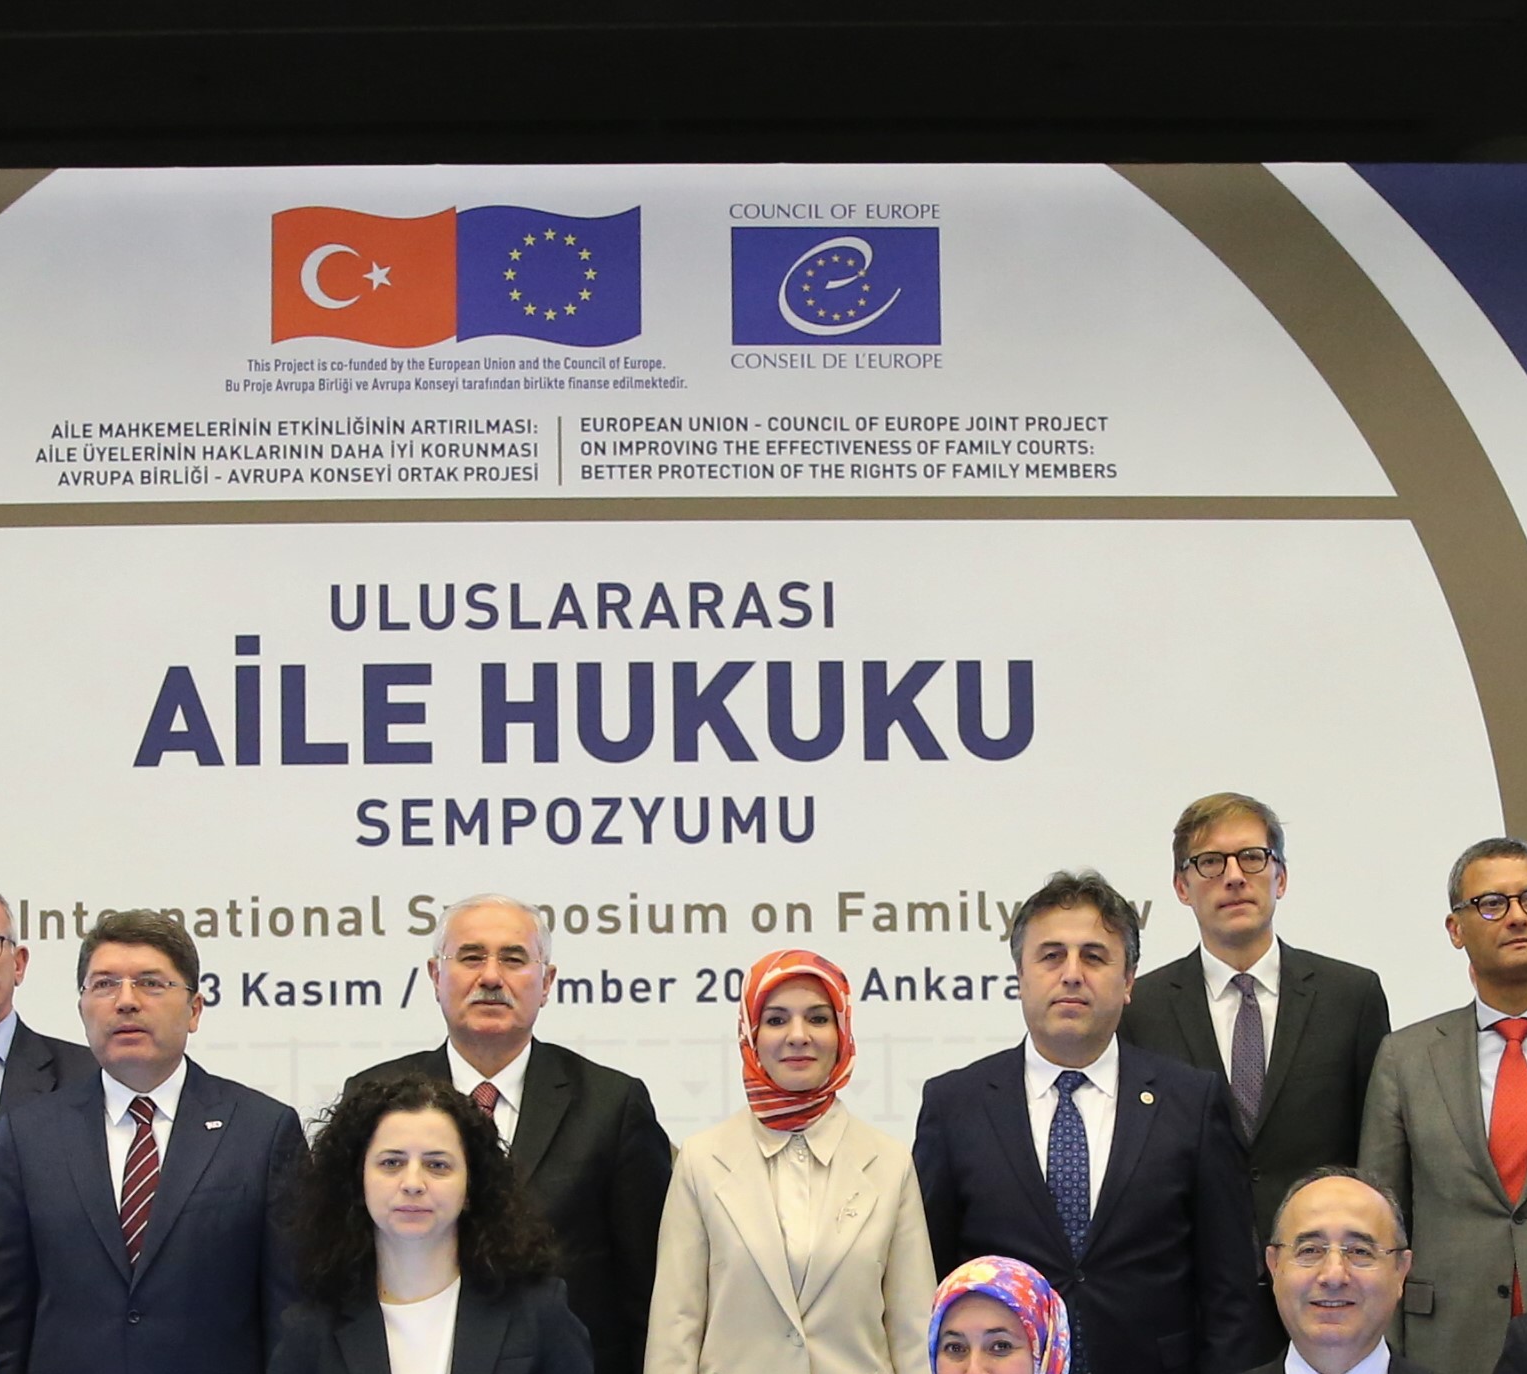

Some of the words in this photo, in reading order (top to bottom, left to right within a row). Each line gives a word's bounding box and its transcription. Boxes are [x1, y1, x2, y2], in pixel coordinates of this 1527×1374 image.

[729, 204, 823, 219] COUNCIL
[831, 204, 856, 219] OF
[867, 204, 939, 219] EUROPE
[248, 359, 270, 371] This
[275, 359, 314, 374] Project
[318, 359, 327, 371] is
[331, 358, 387, 371] co-funded
[391, 358, 404, 373] by
[407, 358, 425, 370] the
[429, 358, 480, 373] European
[484, 358, 515, 370] Union
[519, 357, 539, 370] and
[543, 357, 560, 369] the
[564, 357, 606, 369] Council
[609, 357, 620, 369] of
[624, 357, 665, 372] Europe.
[731, 353, 815, 368] CONSEIL
[823, 353, 846, 368] DE
[856, 353, 941, 368] L'EUROPE
[226, 379, 239, 392] Bu
[244, 379, 272, 394] Proje
[276, 379, 315, 393] Avrupa
[319, 378, 352, 393] Birliği
[356, 381, 368, 390] ve
[372, 378, 411, 392] Avrupa
[415, 378, 458, 392] Konseyi
[462, 377, 520, 389] tarafından
[524, 377, 564, 389] birlikte
[568, 377, 609, 389] finanse
[613, 376, 687, 389] edilmektedir.
[52, 421, 92, 438] AİLE
[100, 418, 270, 438] MAHKEMELERİNİN
[278, 417, 404, 435] ETKİNLİĞİNİN
[411, 419, 537, 434] ARTIRILMASI:
[581, 417, 682, 432] EUROPEAN
[689, 417, 747, 431] UNION
[768, 417, 849, 431] COUNCIL
[856, 417, 878, 431] OF
[886, 417, 959, 431] EUROPE
[966, 417, 1019, 431] JOINT
[1026, 417, 1108, 431] PROJECT
[36, 445, 76, 462] AİLE
[84, 443, 195, 462] ÜYELERİNİN
[203, 445, 323, 460] HAKLARININ
[331, 444, 383, 458] DAHA
[391, 440, 413, 458] İYİ
[422, 443, 537, 457] KORUNMASI
[581, 441, 606, 455] ON
[613, 441, 717, 455] IMPROVING
[724, 441, 759, 455] THE
[767, 440, 911, 455] EFFECTIVENESS
[917, 440, 940, 454] OF
[946, 440, 1011, 454] FAMILY
[1017, 440, 1093, 454] COURTS:
[58, 471, 134, 486] AVRUPA
[141, 466, 207, 484] BİRLİĞİ
[228, 469, 304, 483] AVRUPA
[311, 464, 391, 482] KONSEYİ
[398, 467, 458, 482] ORTAK
[464, 463, 538, 481] PROJESİ
[582, 465, 652, 479] BETTER
[659, 464, 774, 479] PROTECTION
[781, 464, 803, 478] OF
[809, 464, 844, 478] THE
[851, 464, 917, 478] RIGHTS
[924, 464, 946, 478] OF
[953, 464, 1019, 478] FAMILY
[1026, 464, 1117, 478] MEMBERS
[331, 582, 833, 631] ULUSLARARASI
[133, 634, 433, 768] AİLE
[480, 659, 1036, 764] HUKUKU
[357, 796, 814, 846] SEMPOZYUMU
[751, 900, 814, 933] on
[838, 890, 1022, 941] Family
[242, 968, 382, 1007] Kasım
[401, 968, 418, 1008] /
[860, 966, 1021, 1002] Ankara
